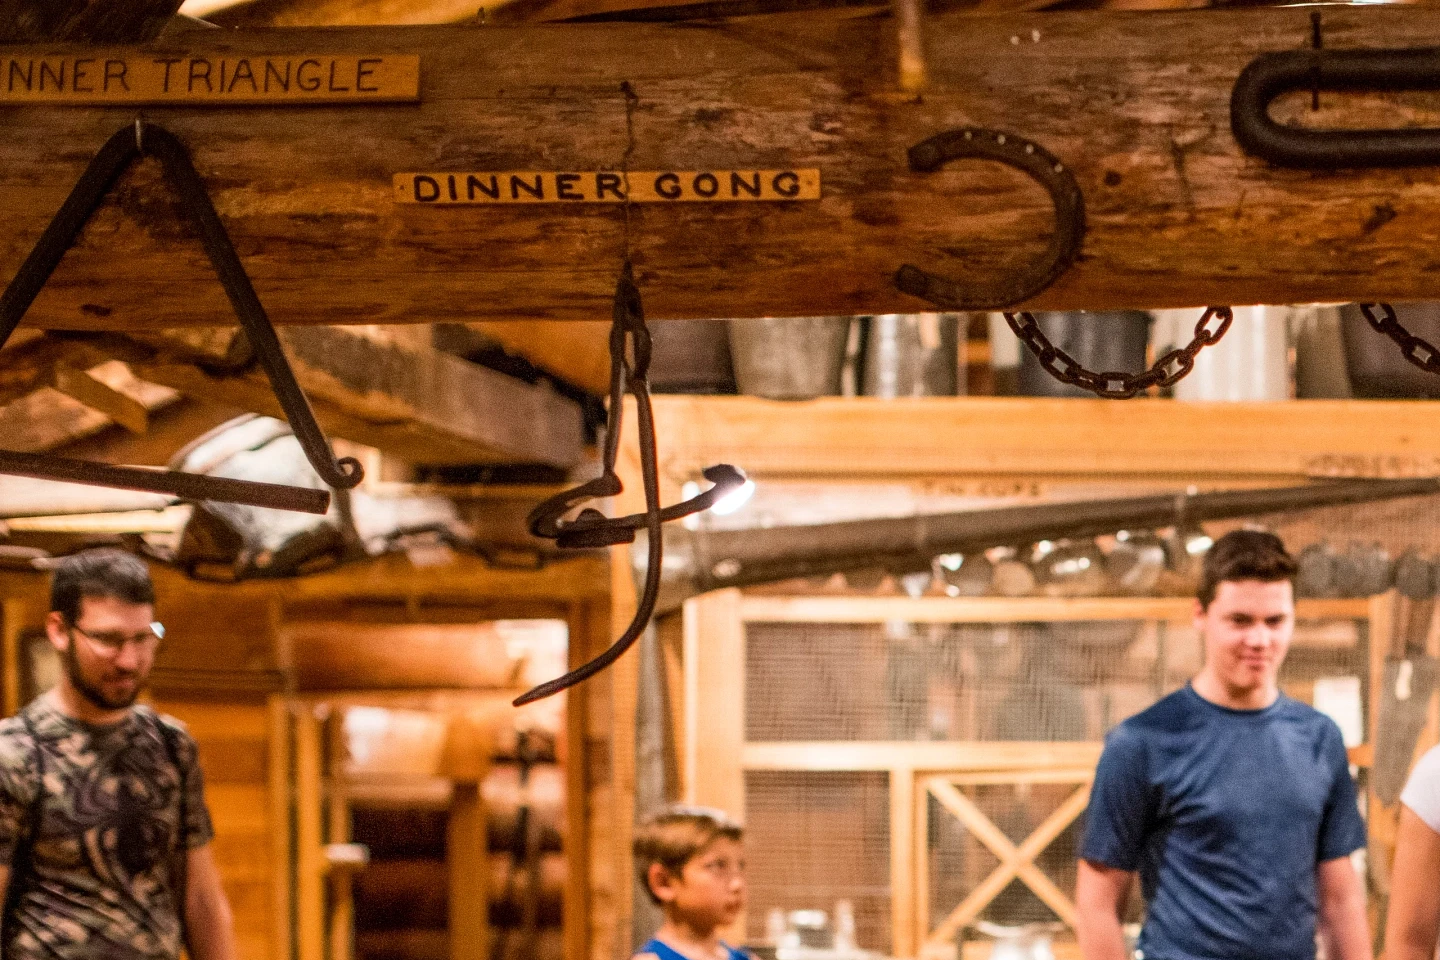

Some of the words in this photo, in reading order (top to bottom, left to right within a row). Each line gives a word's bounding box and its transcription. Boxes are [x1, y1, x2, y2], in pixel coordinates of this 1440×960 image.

[152, 58, 383, 93] TRIANGLE
[413, 172, 626, 201] DINNER
[653, 171, 801, 200] GONG
